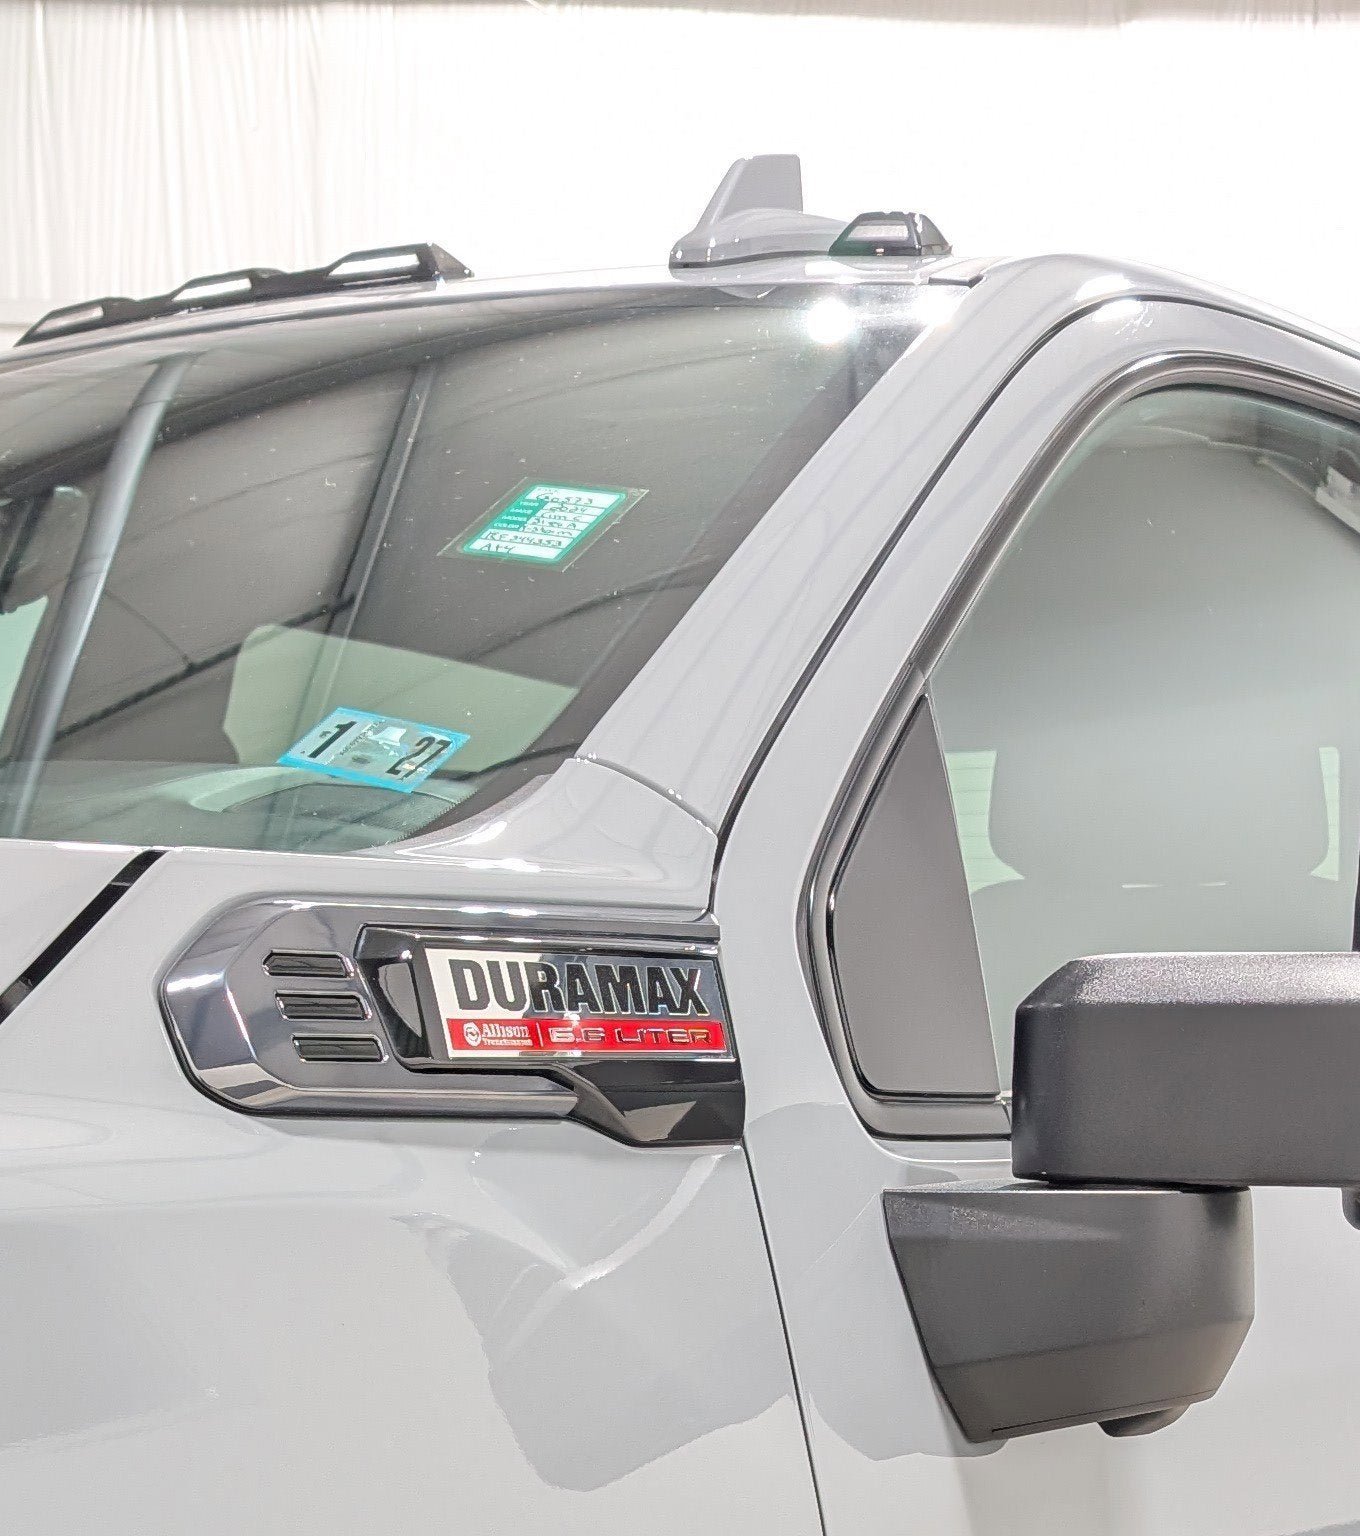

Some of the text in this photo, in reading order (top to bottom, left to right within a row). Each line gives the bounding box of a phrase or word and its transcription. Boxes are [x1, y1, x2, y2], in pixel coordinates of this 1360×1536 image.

[308, 721, 358, 759] 1
[386, 736, 453, 781] 27
[448, 957, 711, 1017] DURAMAX
[482, 1023, 531, 1038] Allison
[614, 1028, 712, 1044] LITER
